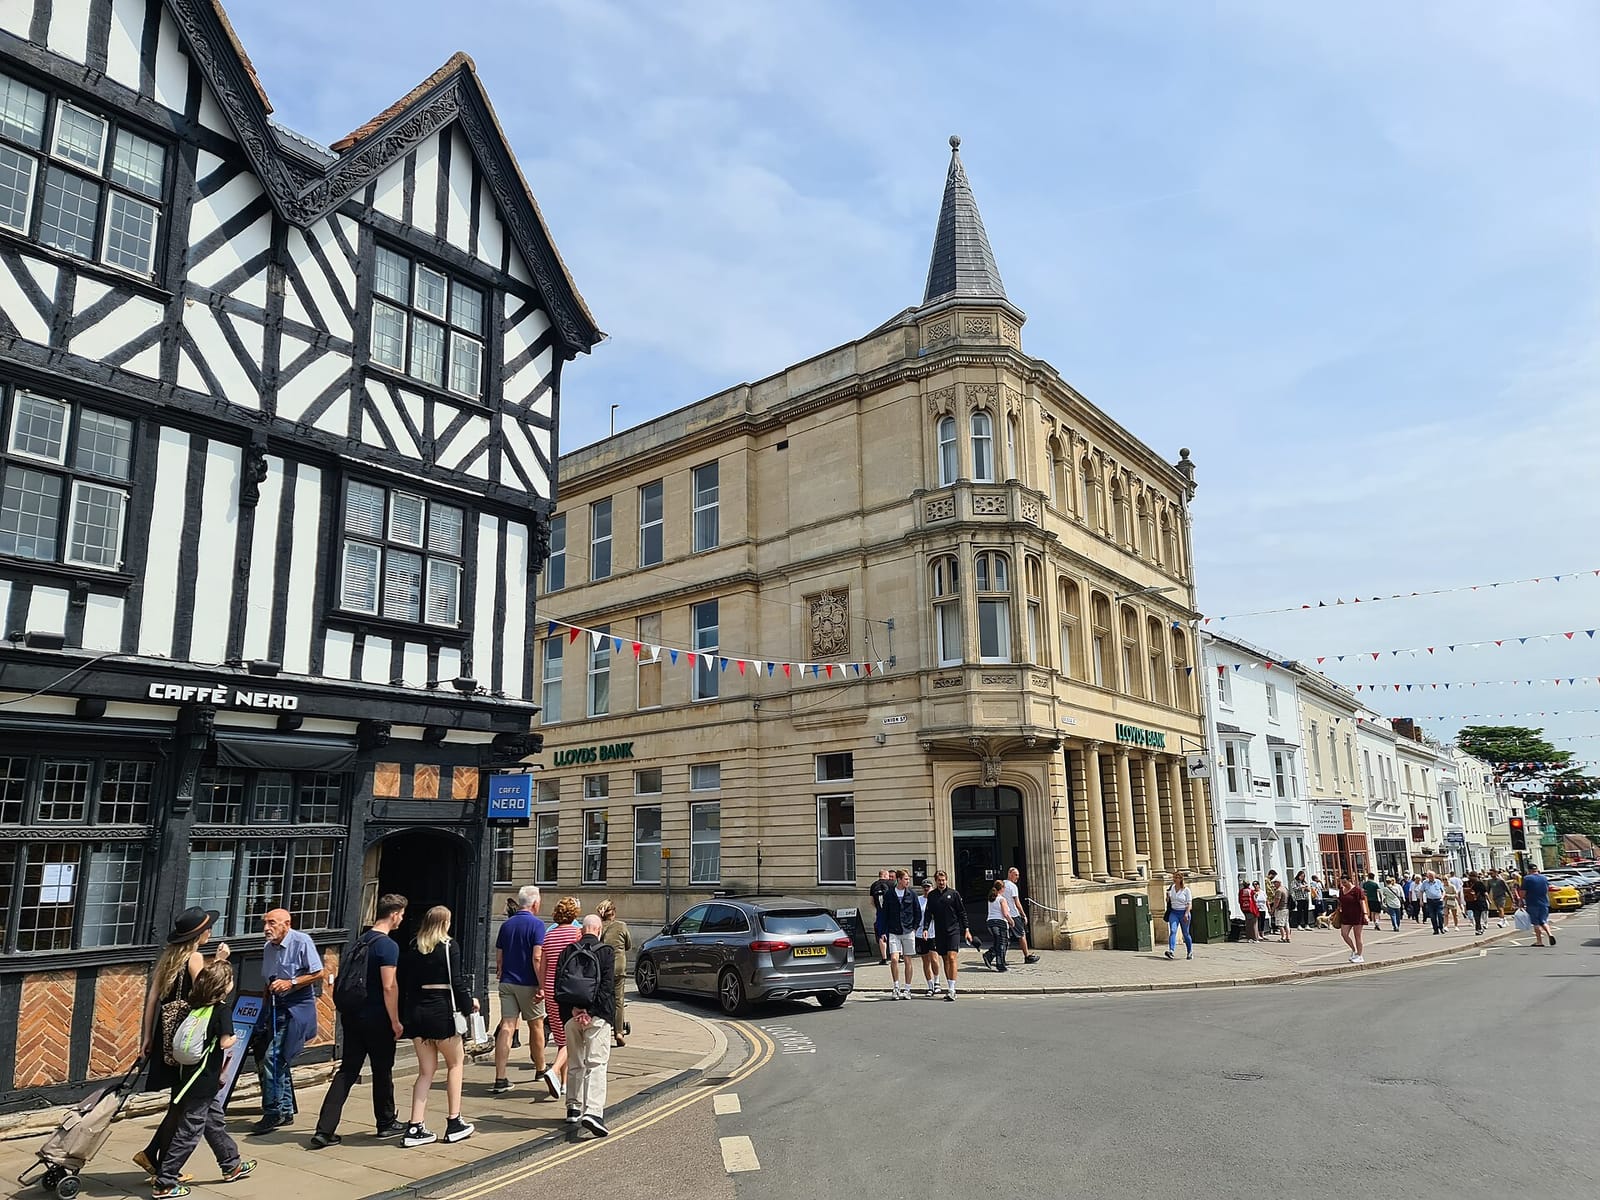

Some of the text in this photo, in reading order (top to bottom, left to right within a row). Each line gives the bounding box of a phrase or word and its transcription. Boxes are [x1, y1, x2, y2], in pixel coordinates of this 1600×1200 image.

[148, 683, 299, 710] CAFFÈ NERO
[1115, 722, 1166, 748] LLOYDS BANK
[553, 741, 635, 767] LLOYDS BANK
[491, 798, 525, 809] NERO
[236, 1006, 258, 1018] NERO
